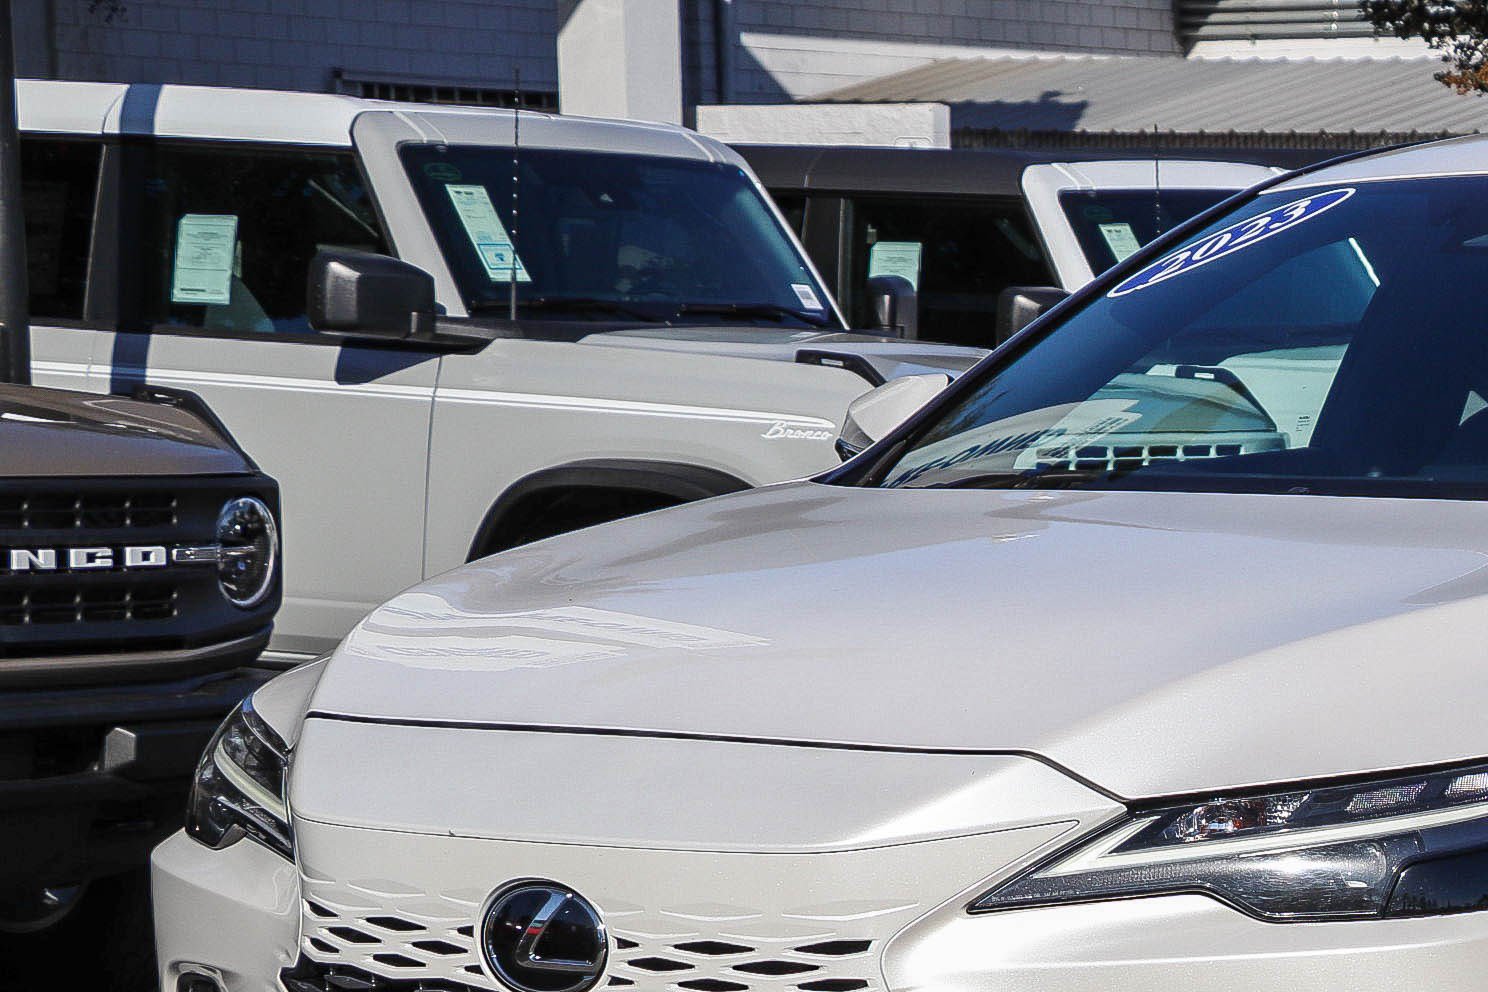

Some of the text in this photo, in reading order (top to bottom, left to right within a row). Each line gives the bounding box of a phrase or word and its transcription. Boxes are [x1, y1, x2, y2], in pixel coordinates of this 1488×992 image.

[1149, 200, 1312, 282] 2023
[760, 420, 833, 440] Bronco
[10, 546, 167, 570] NCO
